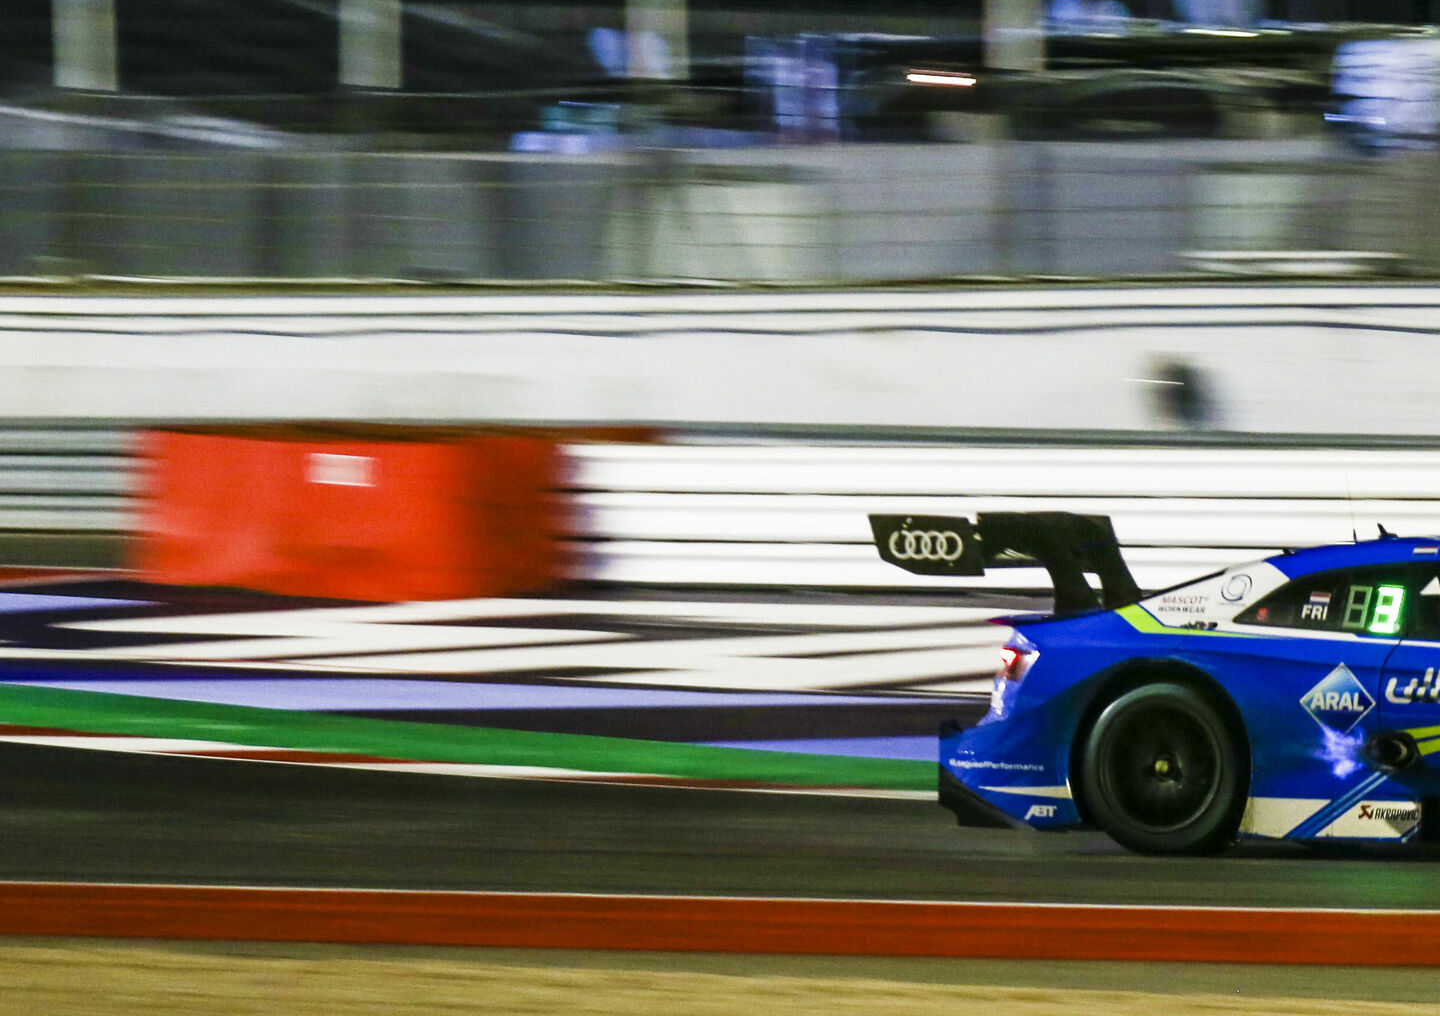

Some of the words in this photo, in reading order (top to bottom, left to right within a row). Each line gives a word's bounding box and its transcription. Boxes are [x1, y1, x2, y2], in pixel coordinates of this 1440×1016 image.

[1301, 605, 1328, 621] FRI
[1310, 691, 1364, 712] ARAL
[1023, 804, 1058, 821] ABT
